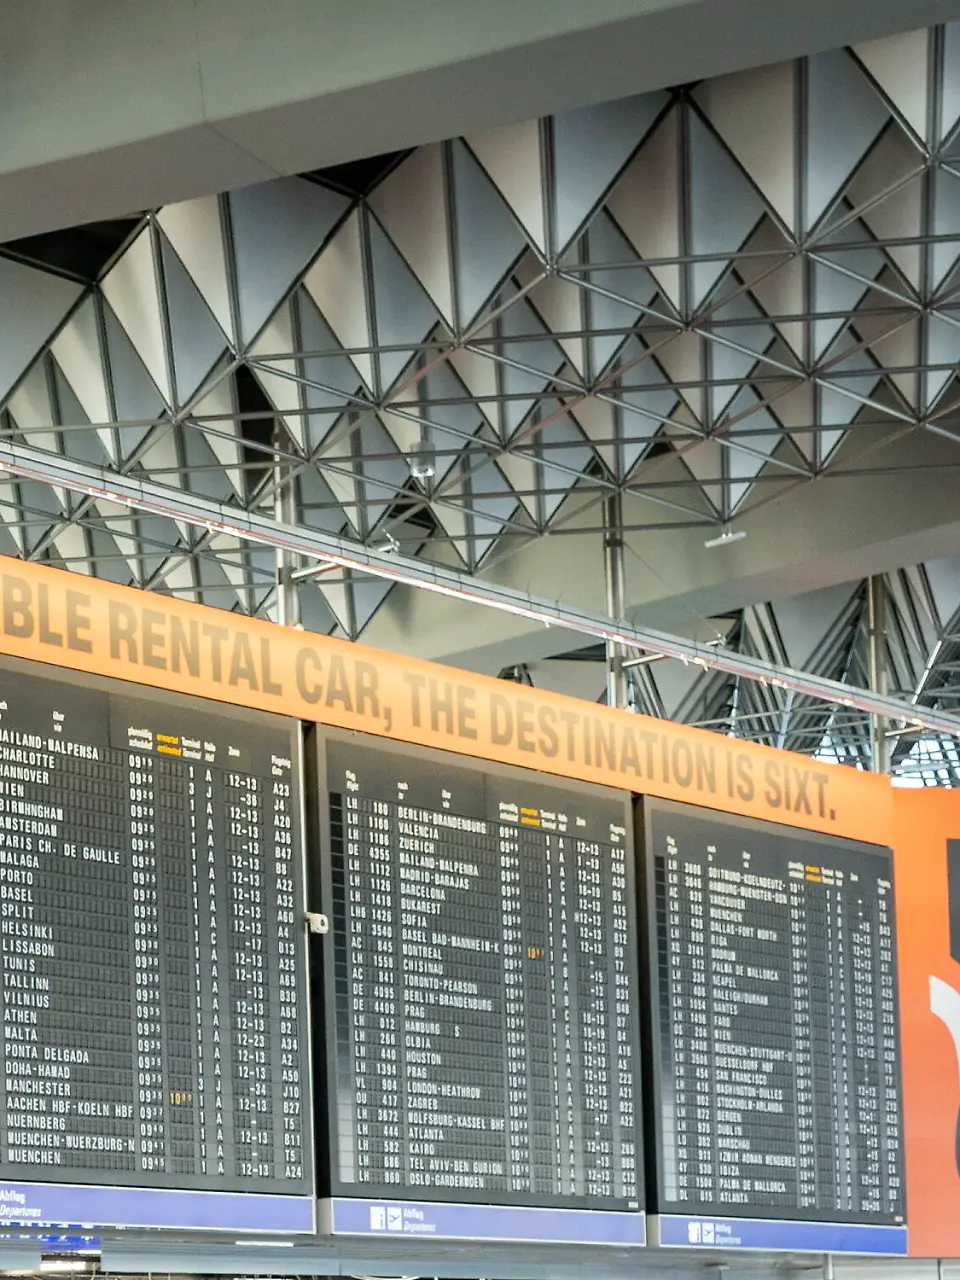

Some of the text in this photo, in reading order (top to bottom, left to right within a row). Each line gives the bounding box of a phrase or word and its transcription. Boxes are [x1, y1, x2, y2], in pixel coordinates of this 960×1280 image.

[110, 603, 283, 696] RENTAL
[295, 646, 394, 732] CAR,
[403, 675, 478, 740] THE
[490, 694, 719, 792] DESTINATION
[726, 753, 756, 800] IS
[763, 765, 838, 822] SIXT.
[0, 832, 119, 864] PARIS DE GAULLE
[0, 867, 32, 884] PORTO
[0, 884, 32, 902] BASEL
[1, 902, 33, 919] SPLIT
[1, 919, 53, 939] HELSINKI
[2, 937, 53, 956] LISSABON
[2, 954, 34, 971] TUNIS
[3, 972, 48, 990] TALLINN
[3, 989, 48, 1007] VILNIUS
[4, 1007, 36, 1023] ATHEN
[4, 1024, 37, 1040] MALTA
[5, 1042, 88, 1062] PONTA DELGADA
[6, 1077, 70, 1095] MANCHESTER
[6, 1094, 133, 1117] AACHEN HBF-KOELN HBF
[7, 1112, 65, 1129] NUERNBERG
[408, 1125, 443, 1140] ATLANTA
[8, 1147, 60, 1163] MUENCHEN
[0, 1189, 26, 1204] Abflug
[0, 1204, 42, 1218] Departures
